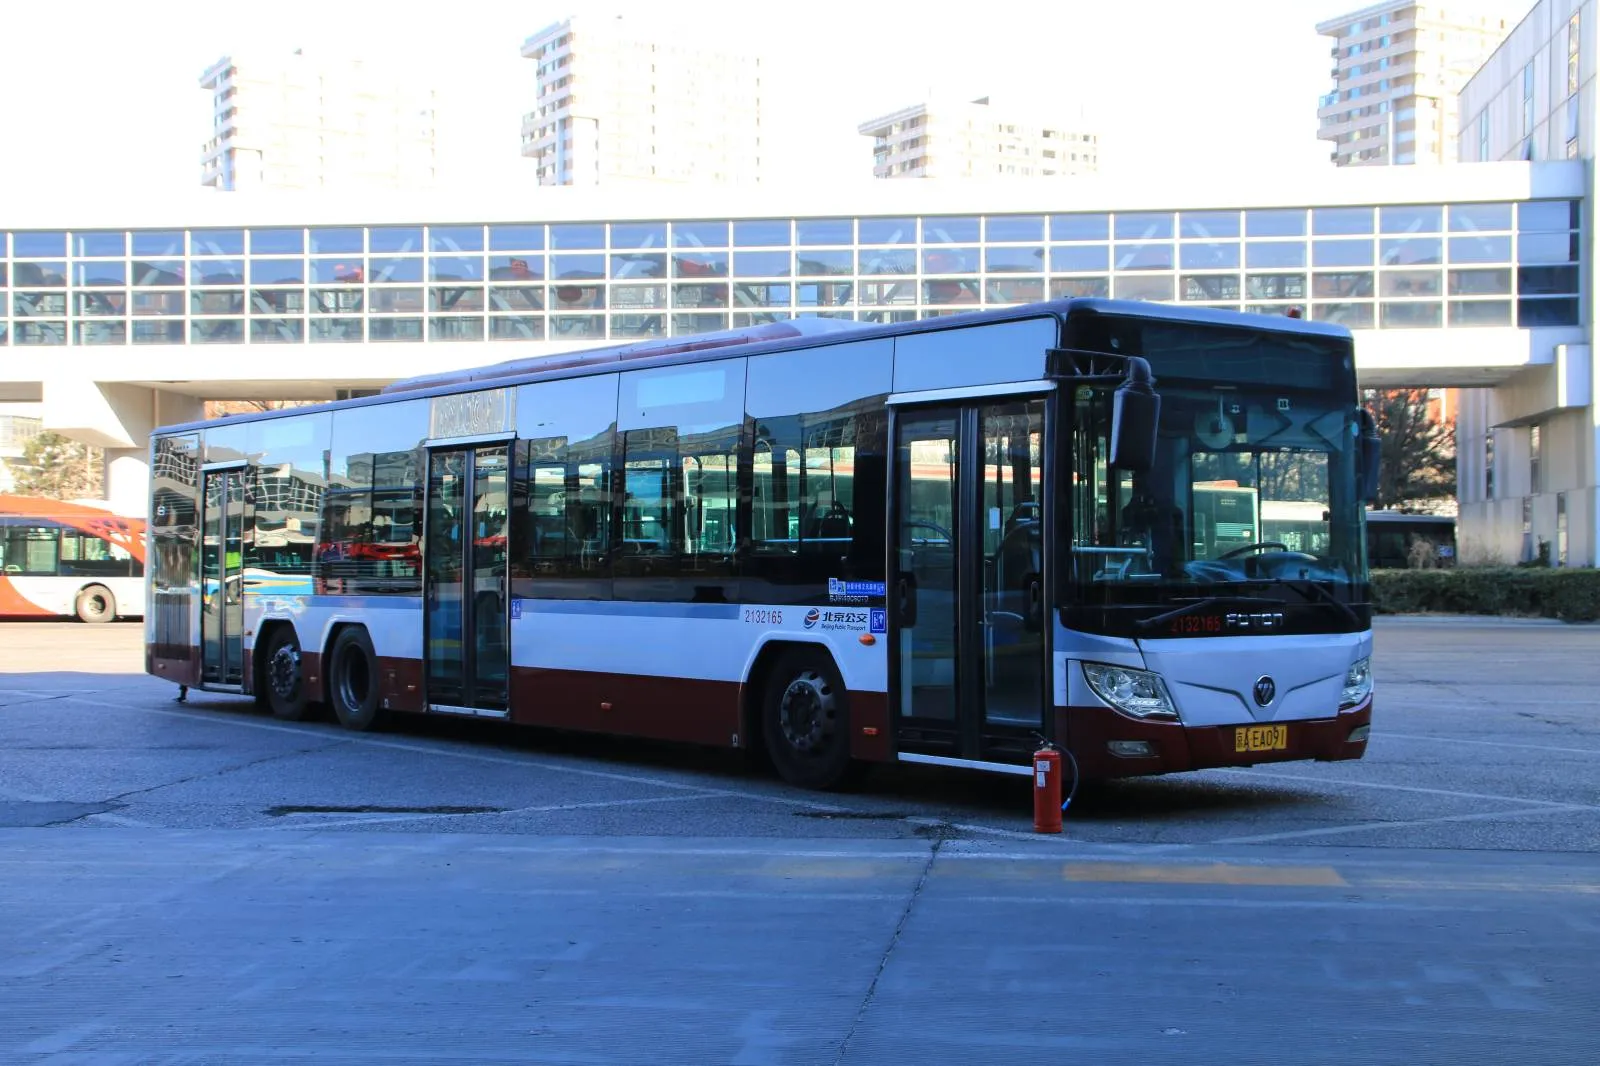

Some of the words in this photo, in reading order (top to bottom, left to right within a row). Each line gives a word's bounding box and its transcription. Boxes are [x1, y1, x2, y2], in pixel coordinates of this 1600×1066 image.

[745, 609, 782, 624] 2132165
[822, 611, 868, 623] 北京公交
